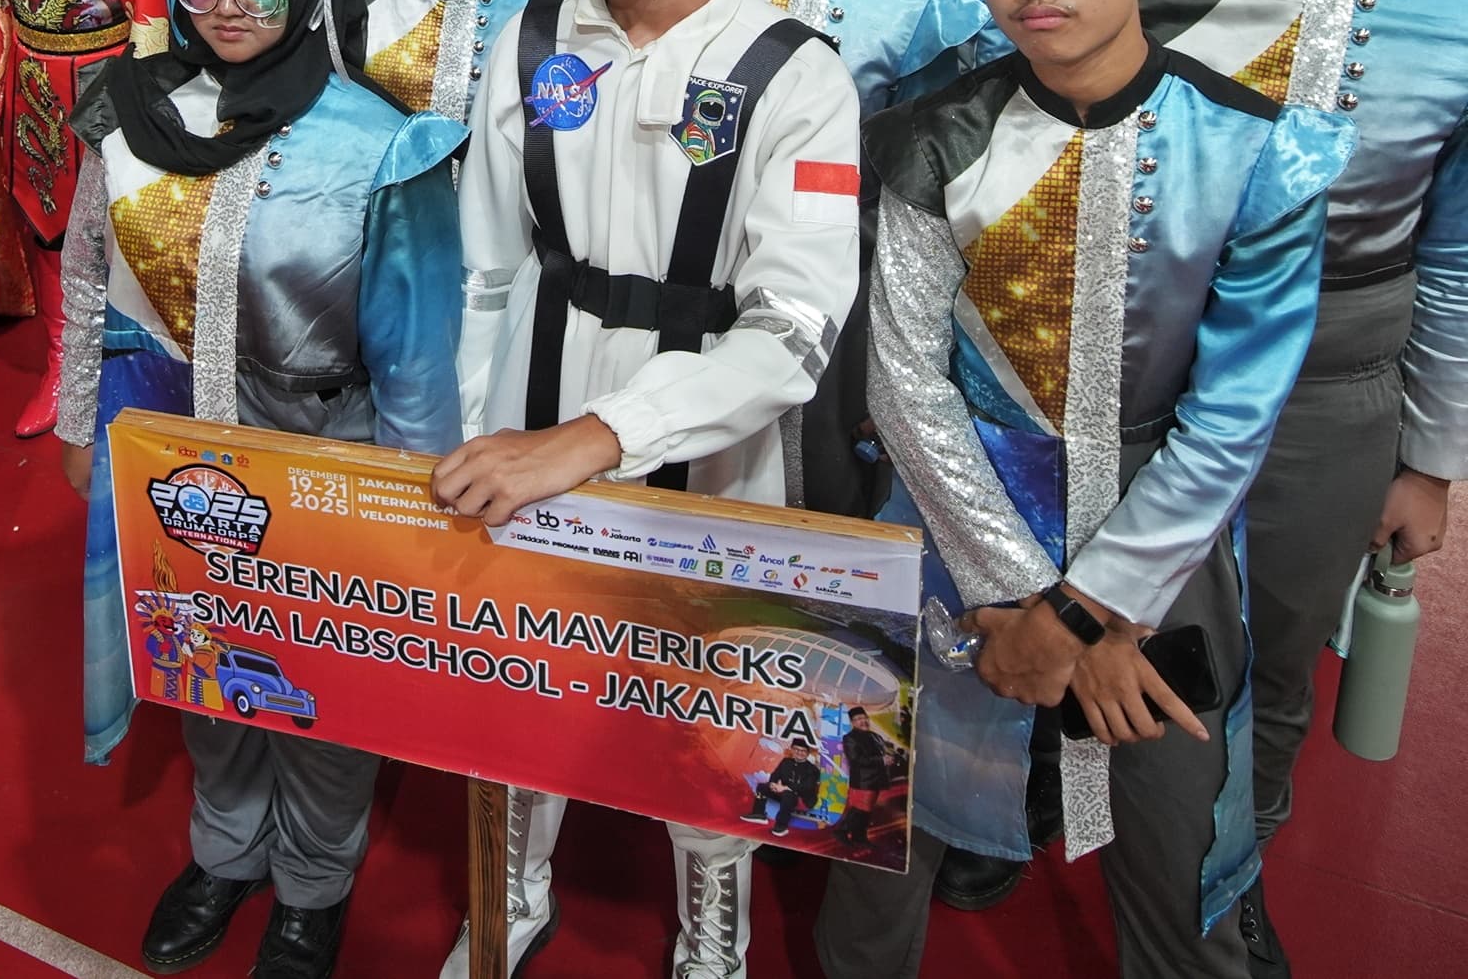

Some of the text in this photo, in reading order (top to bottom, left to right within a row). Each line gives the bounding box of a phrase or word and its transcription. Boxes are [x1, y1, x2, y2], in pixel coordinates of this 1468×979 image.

[536, 81, 594, 106] NASA
[288, 466, 347, 482] DECEMBER
[288, 475, 348, 499] 19-21
[358, 478, 424, 495] JAKARTA
[150, 482, 268, 525] 2025
[290, 492, 349, 516] 2025
[160, 508, 262, 536] JAKARTA
[163, 517, 260, 543] DRUM CORPS
[359, 508, 450, 531] VELODROME
[172, 528, 250, 549] INTERNATIONAL
[609, 533, 642, 543] Jakarta
[759, 554, 785, 567] Ancol
[206, 551, 806, 691] SERENADE LA MAVERICKS
[191, 591, 284, 640] SMA
[291, 611, 563, 699] LABSCHOOL
[596, 671, 818, 747] JAKARTA
